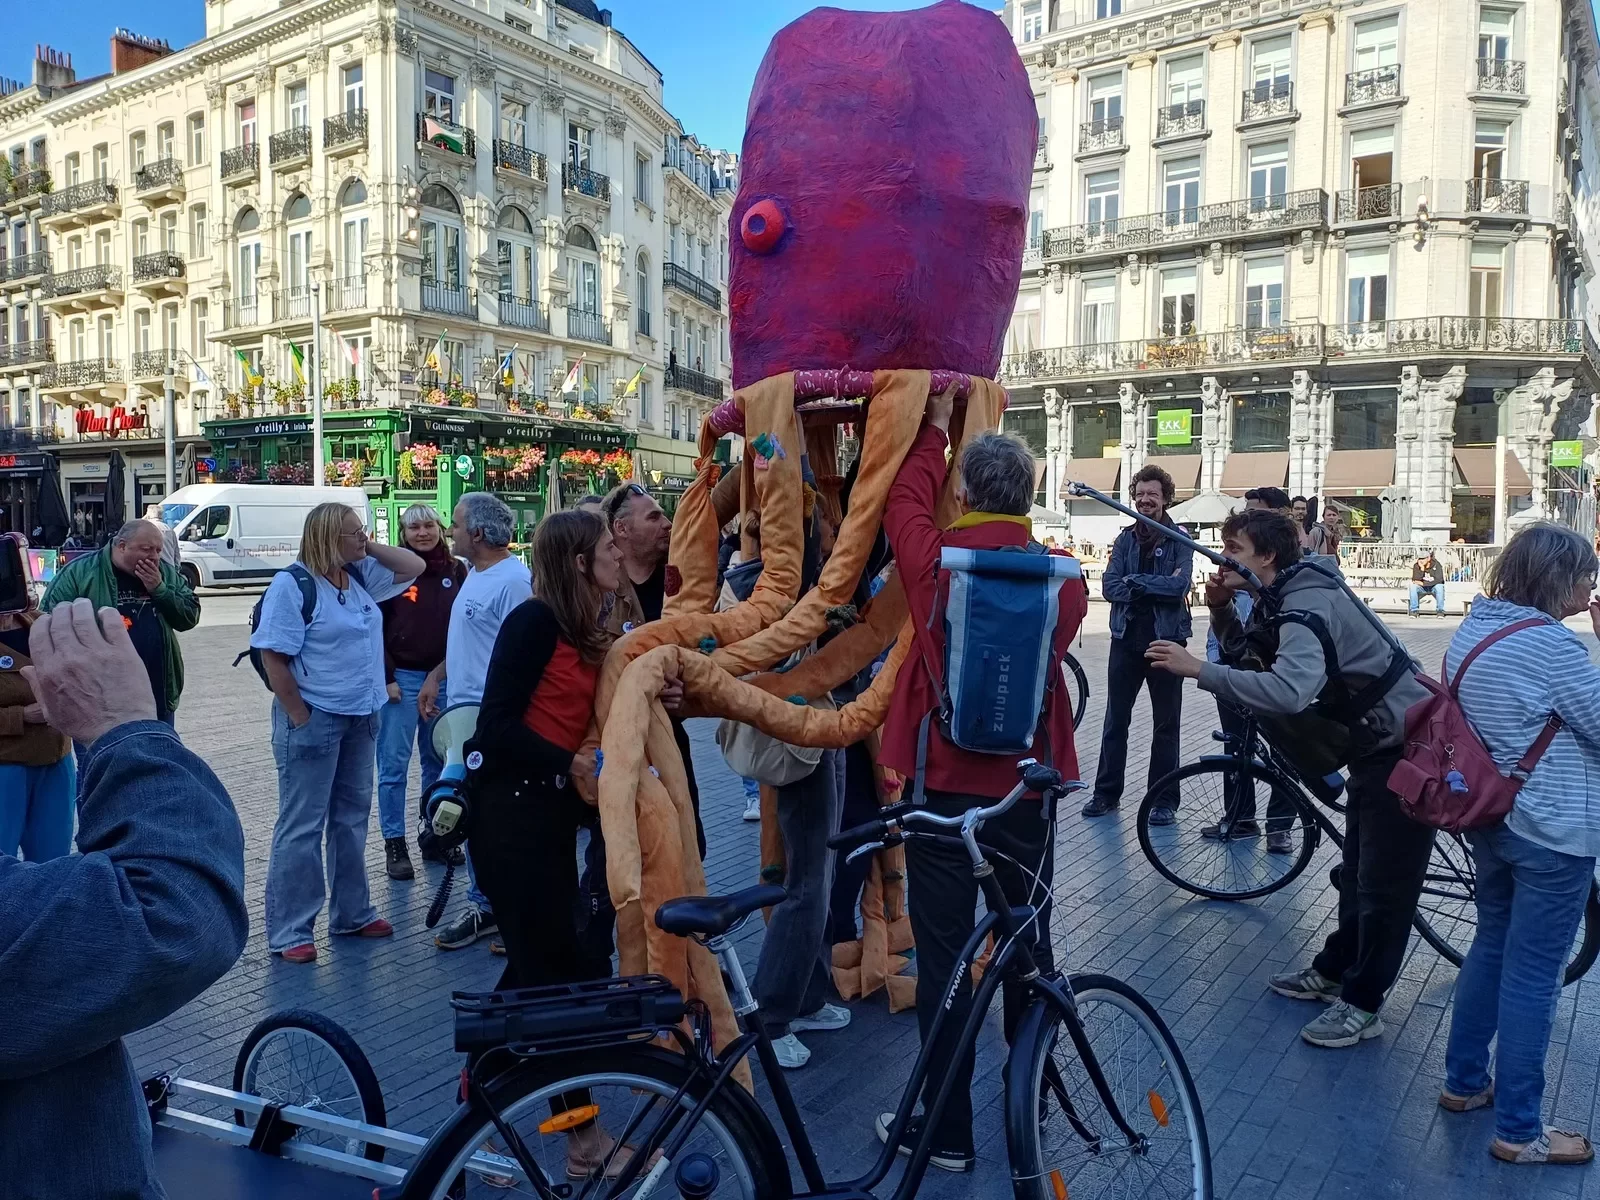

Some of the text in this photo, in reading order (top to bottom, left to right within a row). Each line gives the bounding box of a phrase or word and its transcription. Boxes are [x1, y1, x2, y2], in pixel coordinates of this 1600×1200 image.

[506, 426, 621, 444] o'reilly's irish pub
[993, 653, 1011, 732] zulupack
